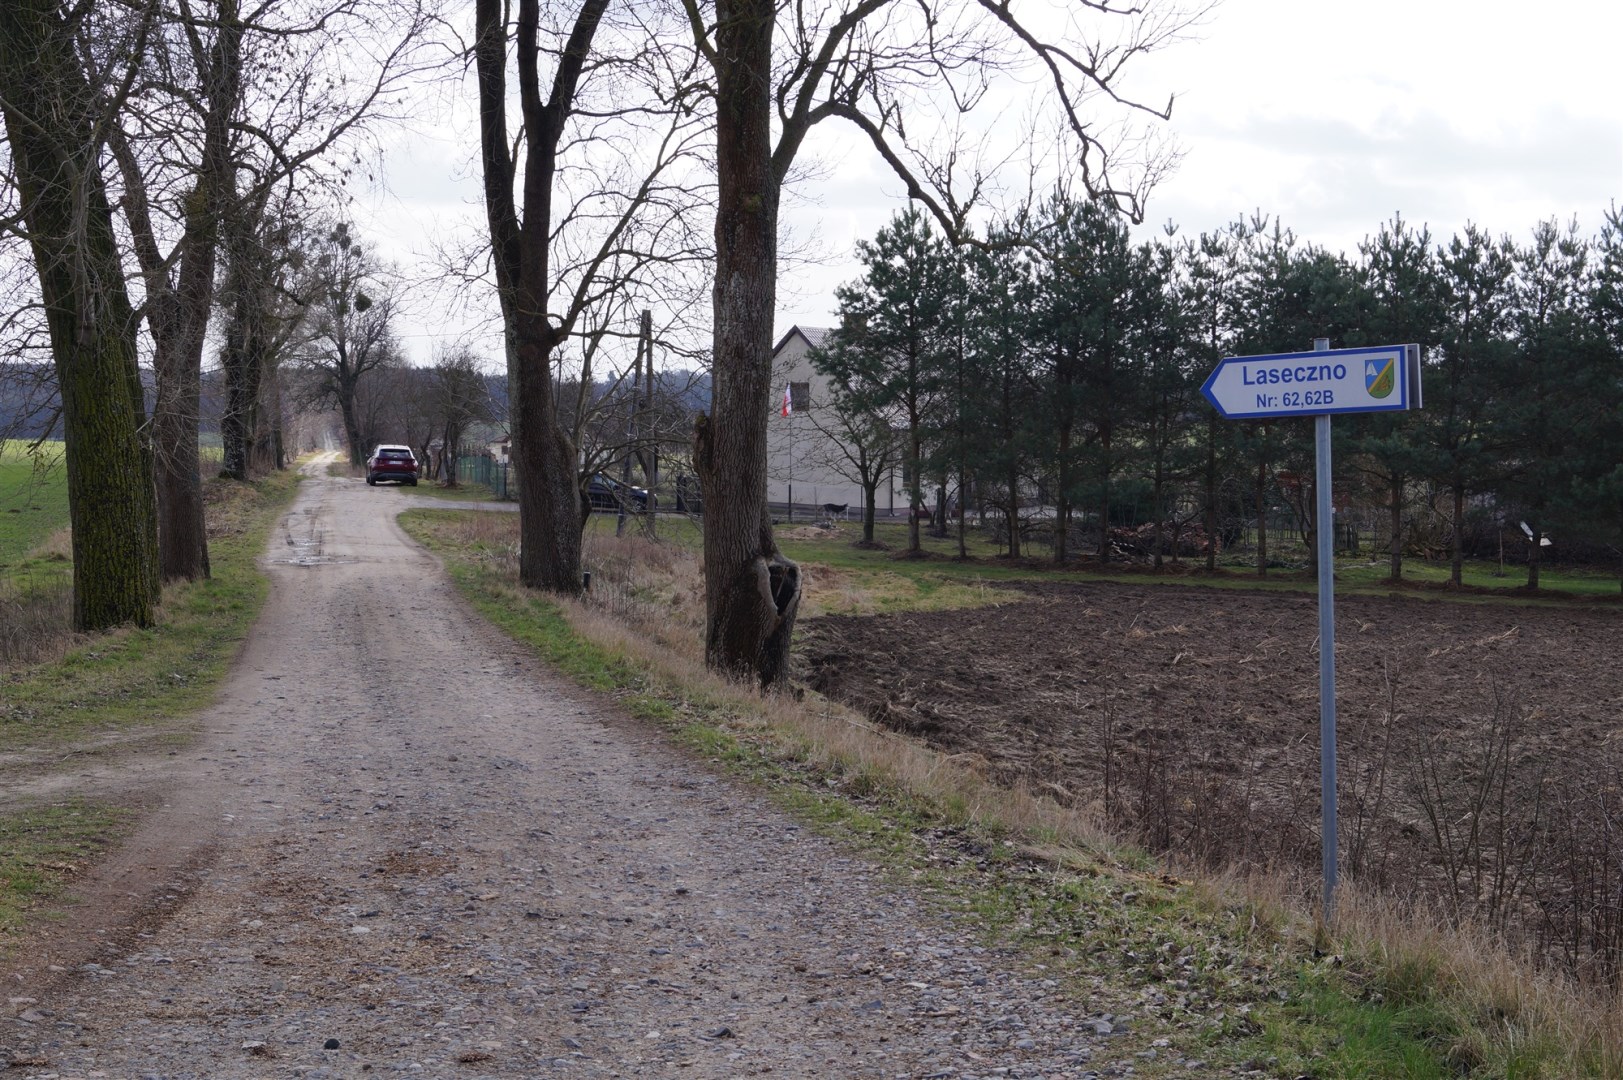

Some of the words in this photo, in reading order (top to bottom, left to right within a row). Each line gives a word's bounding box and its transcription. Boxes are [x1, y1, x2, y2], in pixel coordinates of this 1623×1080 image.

[1243, 364, 1347, 386] Laseczno
[1256, 394, 1278, 408] Nr:
[1282, 390, 1334, 409] 62,62B
